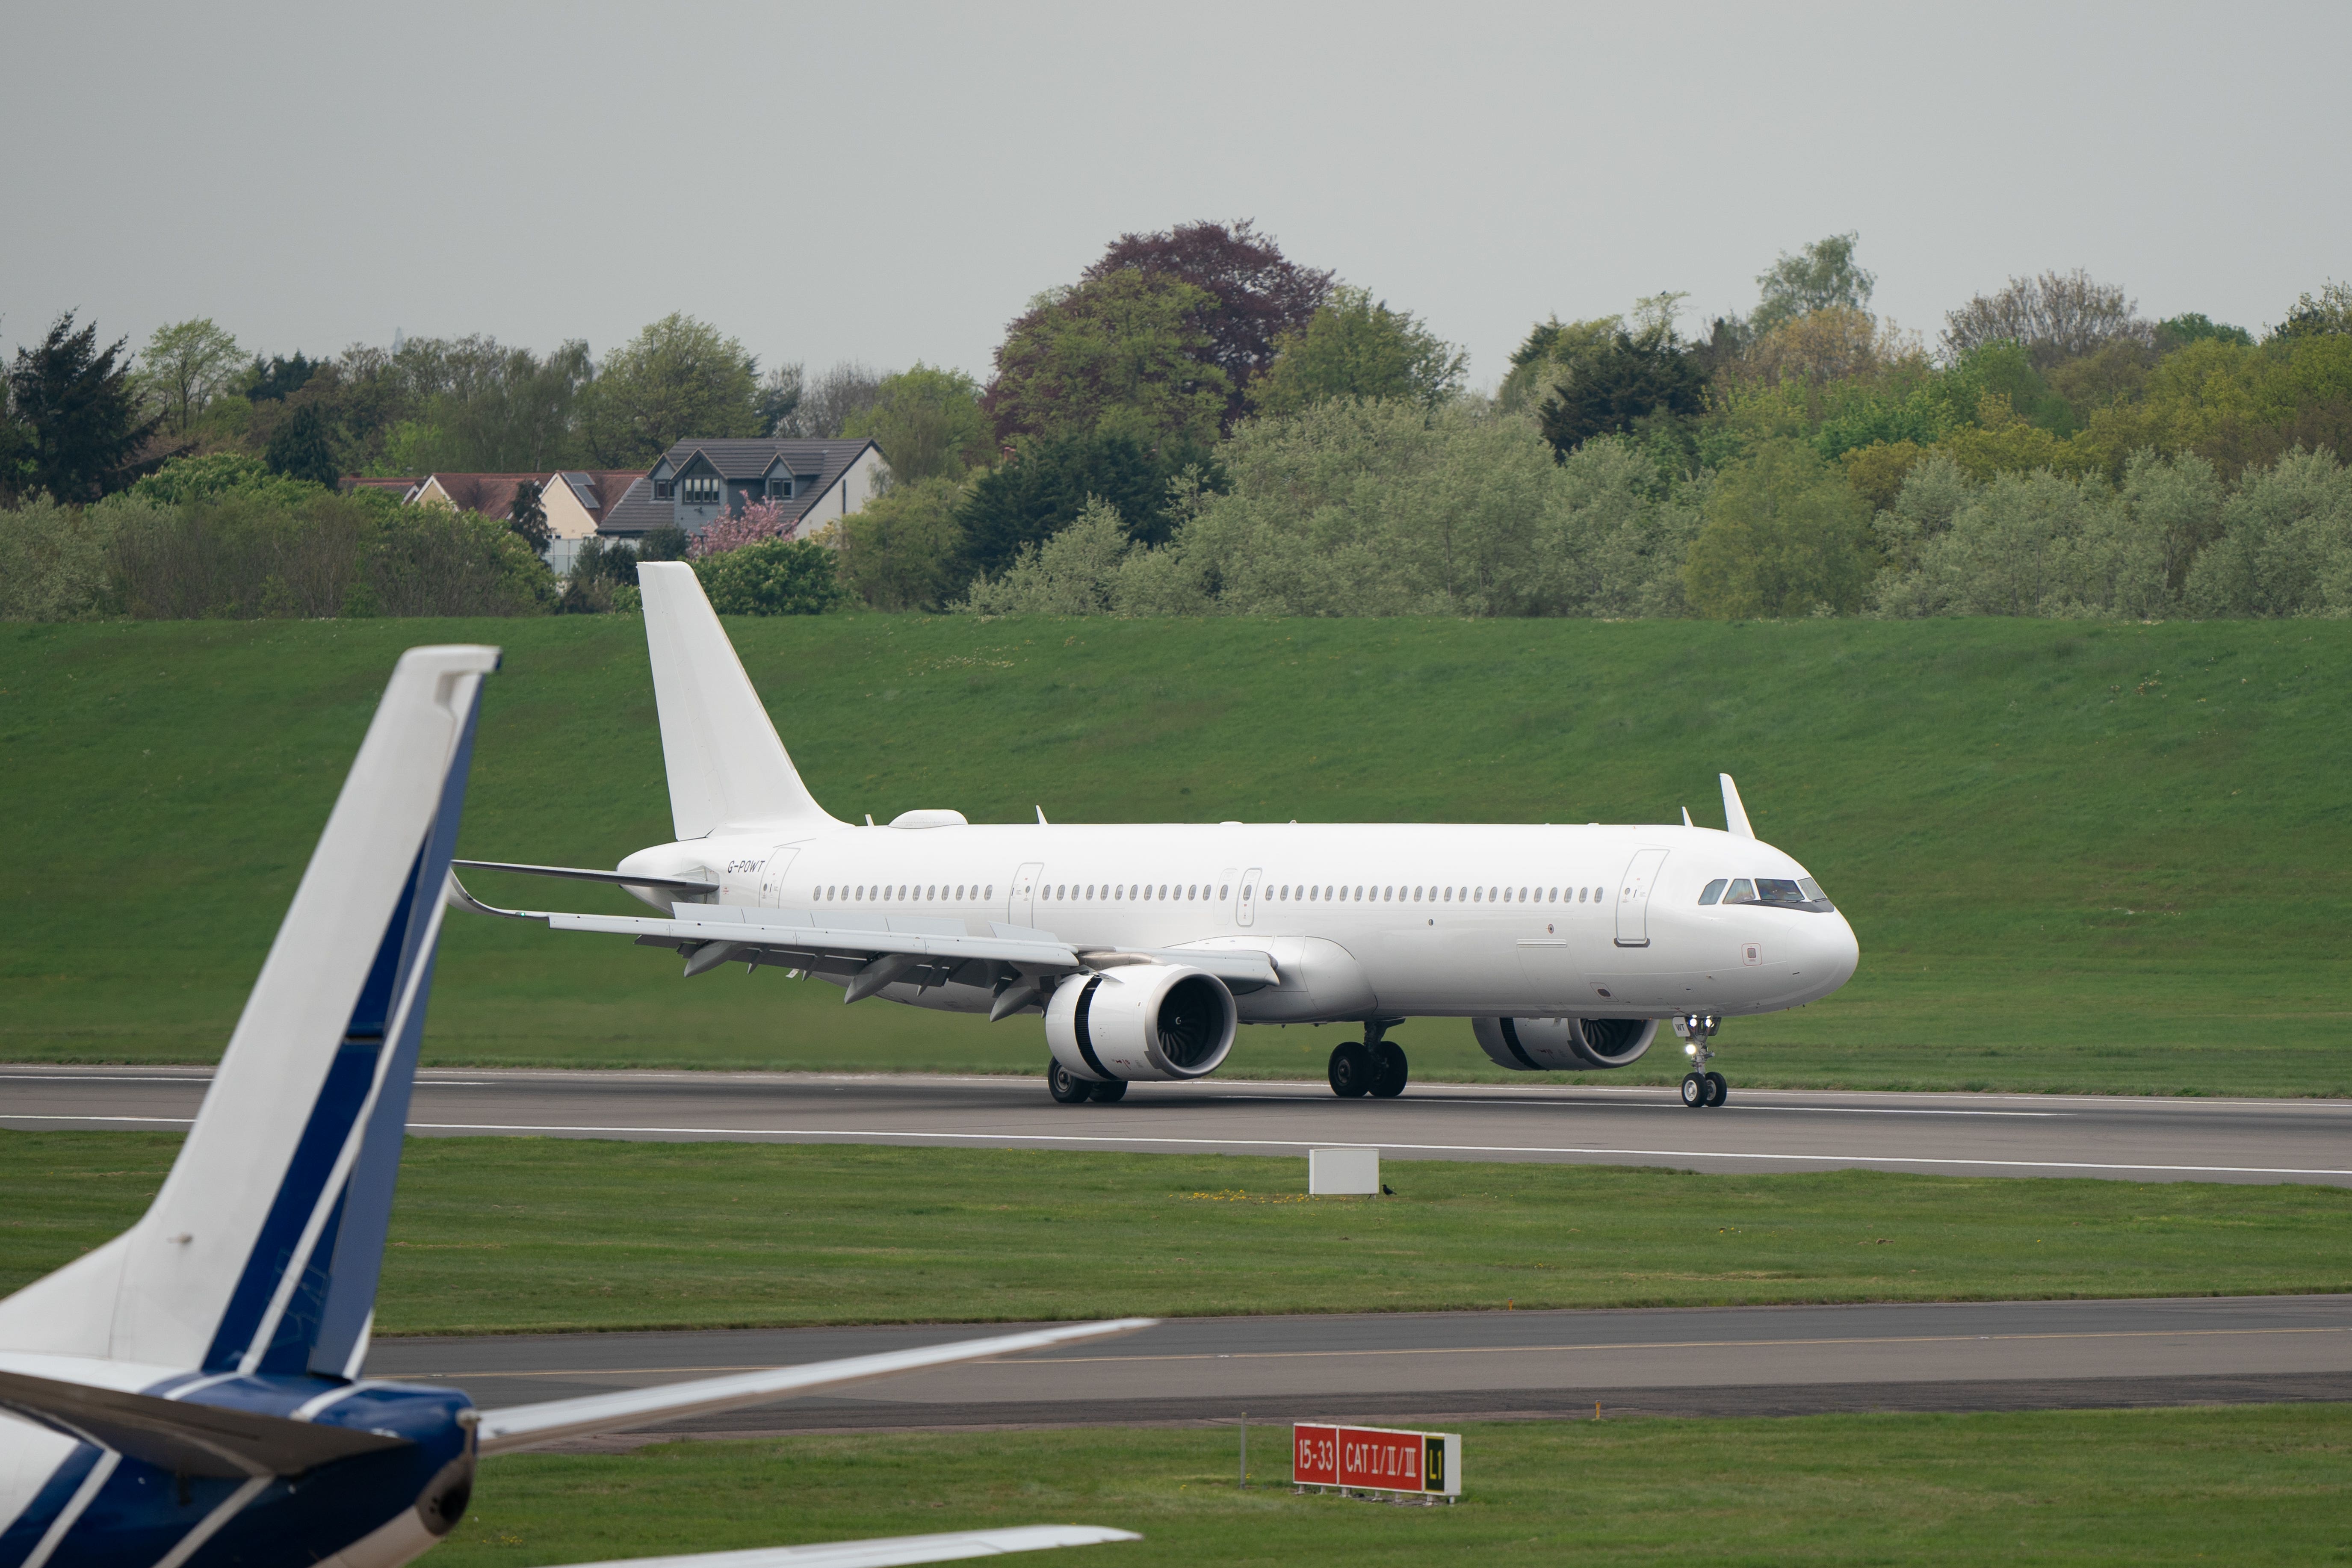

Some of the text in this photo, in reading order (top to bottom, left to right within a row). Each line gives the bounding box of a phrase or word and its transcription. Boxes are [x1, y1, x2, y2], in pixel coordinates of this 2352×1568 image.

[728, 860, 765, 873] G-POWT
[1299, 1439, 1417, 1478] 15-33 CAT I/II/III
[1430, 1449, 1442, 1480] L1
